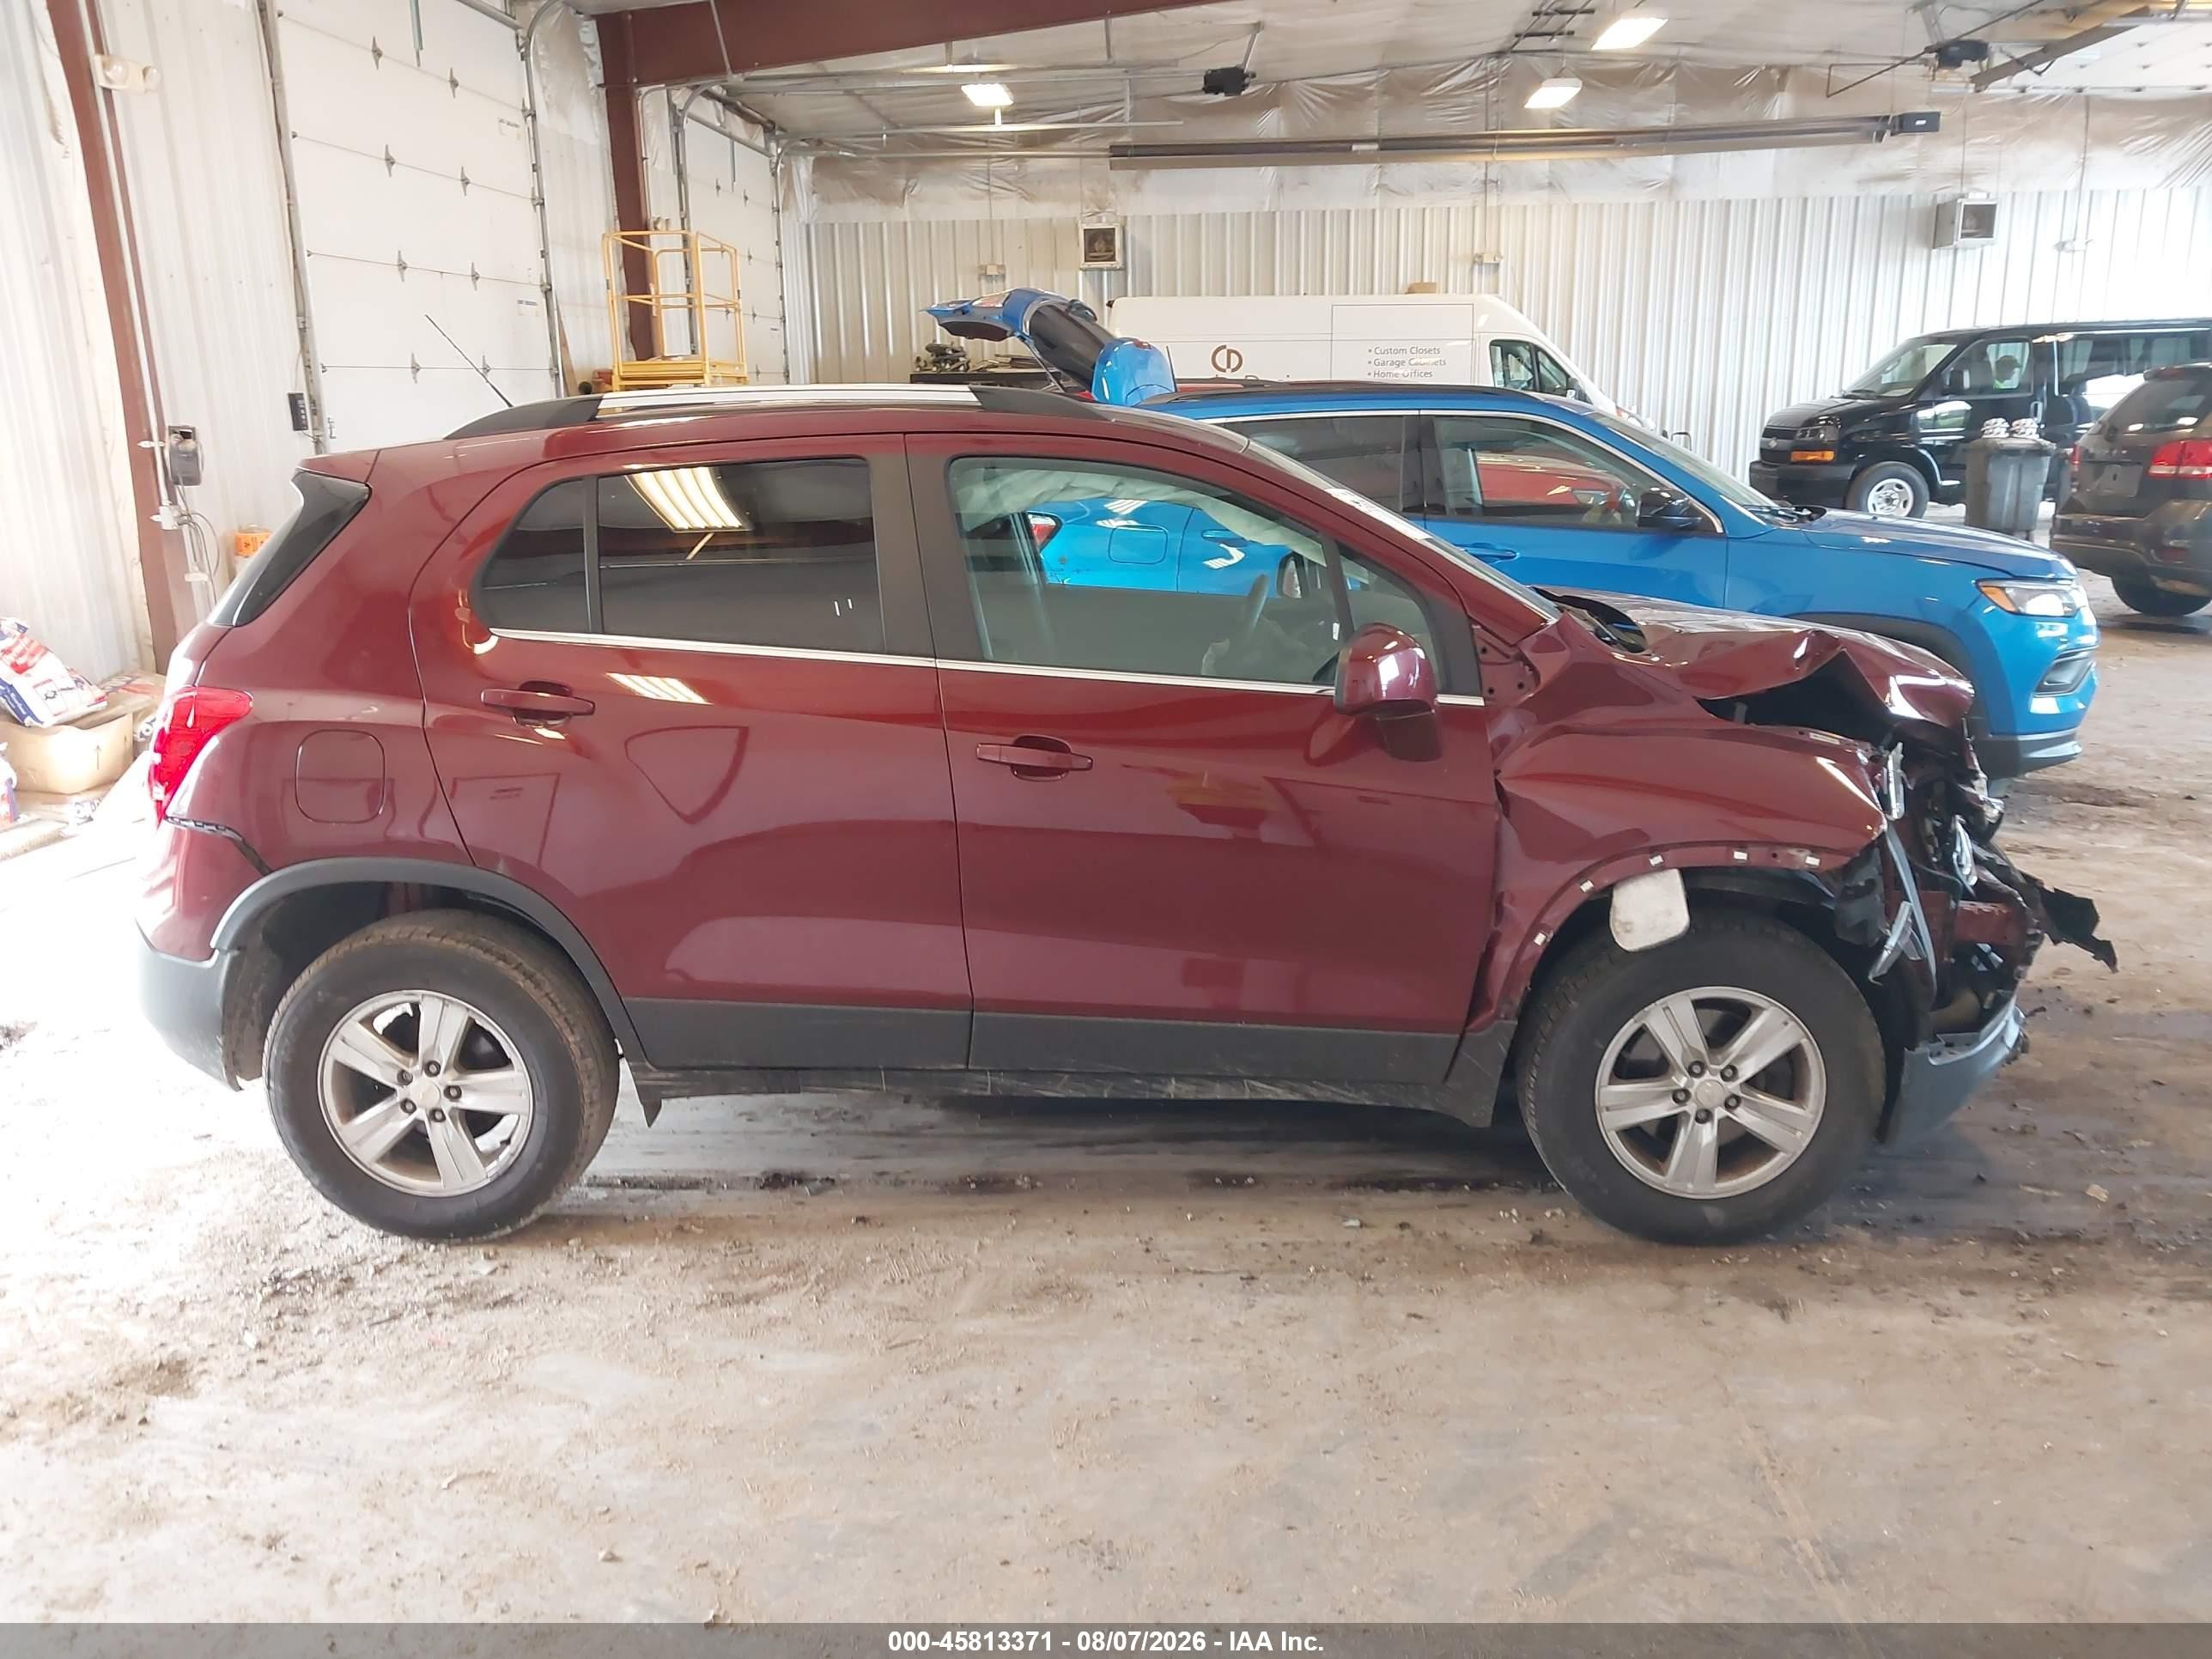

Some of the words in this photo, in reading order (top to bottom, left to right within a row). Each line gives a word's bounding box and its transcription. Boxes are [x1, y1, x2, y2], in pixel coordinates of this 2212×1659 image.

[1374, 346, 1407, 355] Custom
[1409, 345, 1441, 355] Closets
[1373, 358, 1407, 368] Garage
[1408, 357, 1447, 366] Caets
